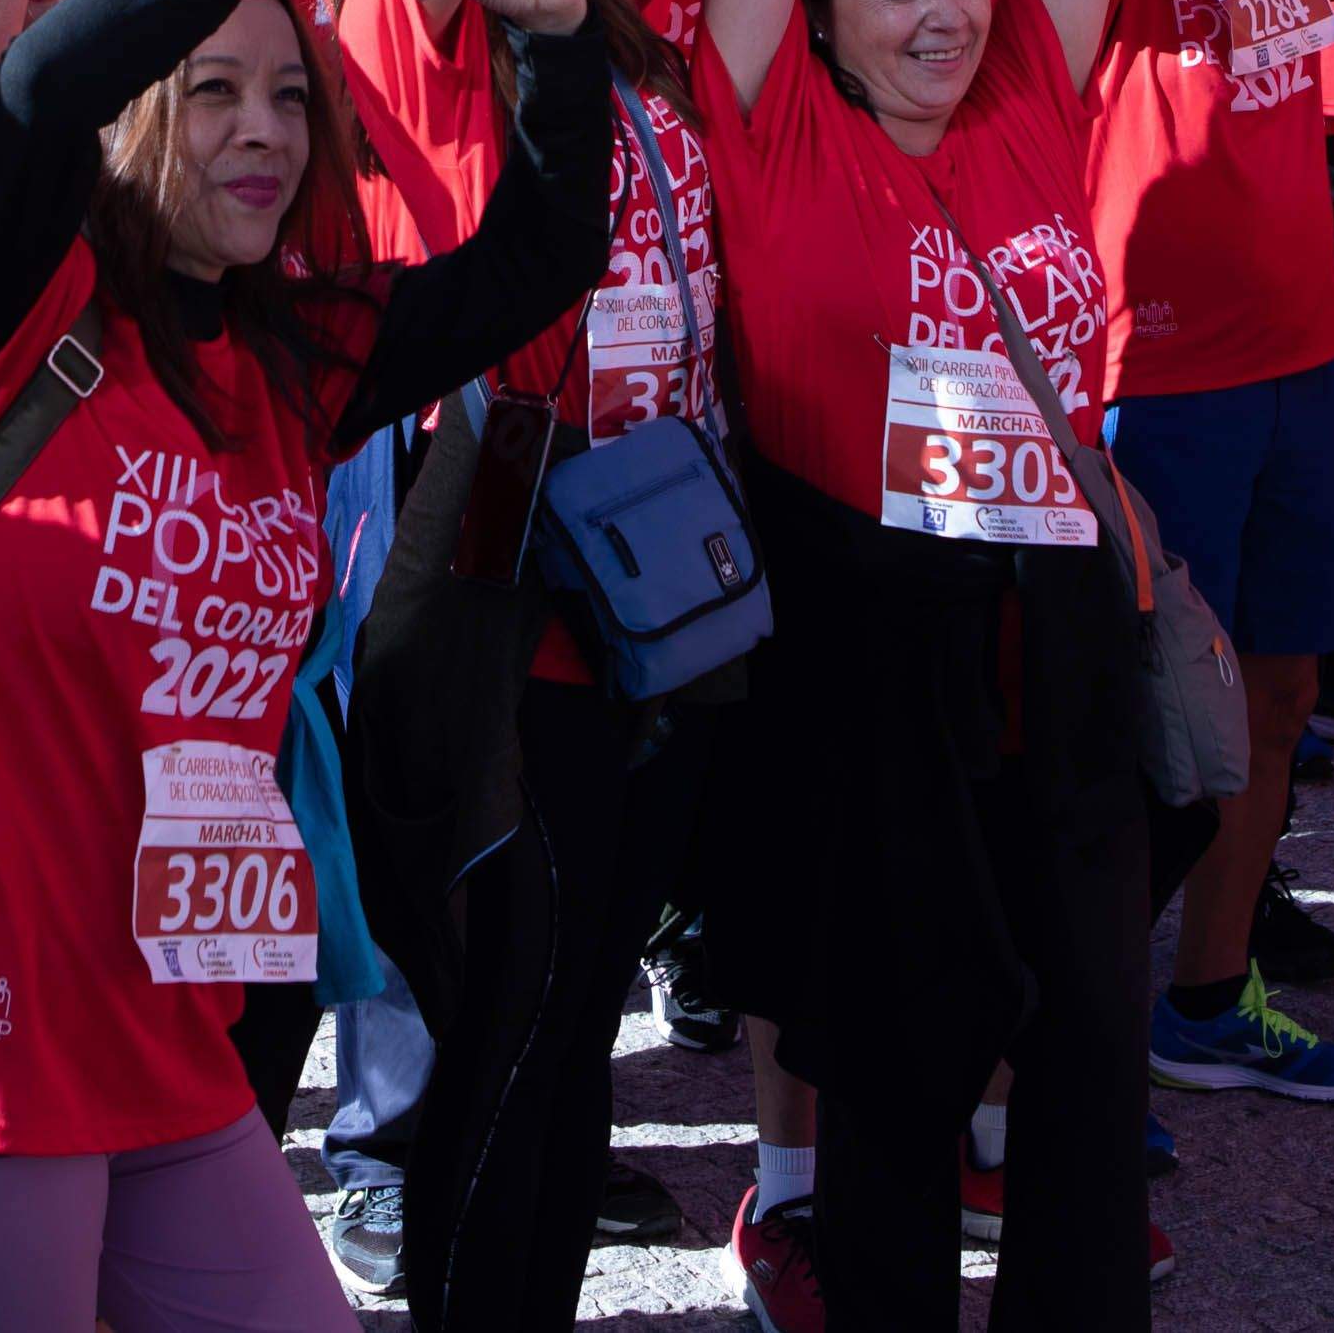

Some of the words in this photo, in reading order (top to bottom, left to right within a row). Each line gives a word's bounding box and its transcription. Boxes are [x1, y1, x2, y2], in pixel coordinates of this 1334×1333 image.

[617, 316, 636, 333] DEL
[911, 356, 928, 373] XIII
[932, 360, 993, 380] CARRERA
[624, 356, 715, 430] 330
[919, 376, 939, 393] DEL
[945, 380, 1008, 400] CORAZÓN
[957, 414, 1033, 433] MARCHA
[116, 445, 197, 505] XIII
[920, 435, 1077, 504] 3305
[926, 509, 944, 523] 20
[104, 491, 318, 602] POPULA
[91, 566, 183, 633] DEL
[140, 637, 288, 719] 2022
[178, 757, 227, 778] CARRERA
[170, 781, 187, 802] DEL
[198, 823, 261, 843] MARCHA
[159, 853, 298, 933] 3306
